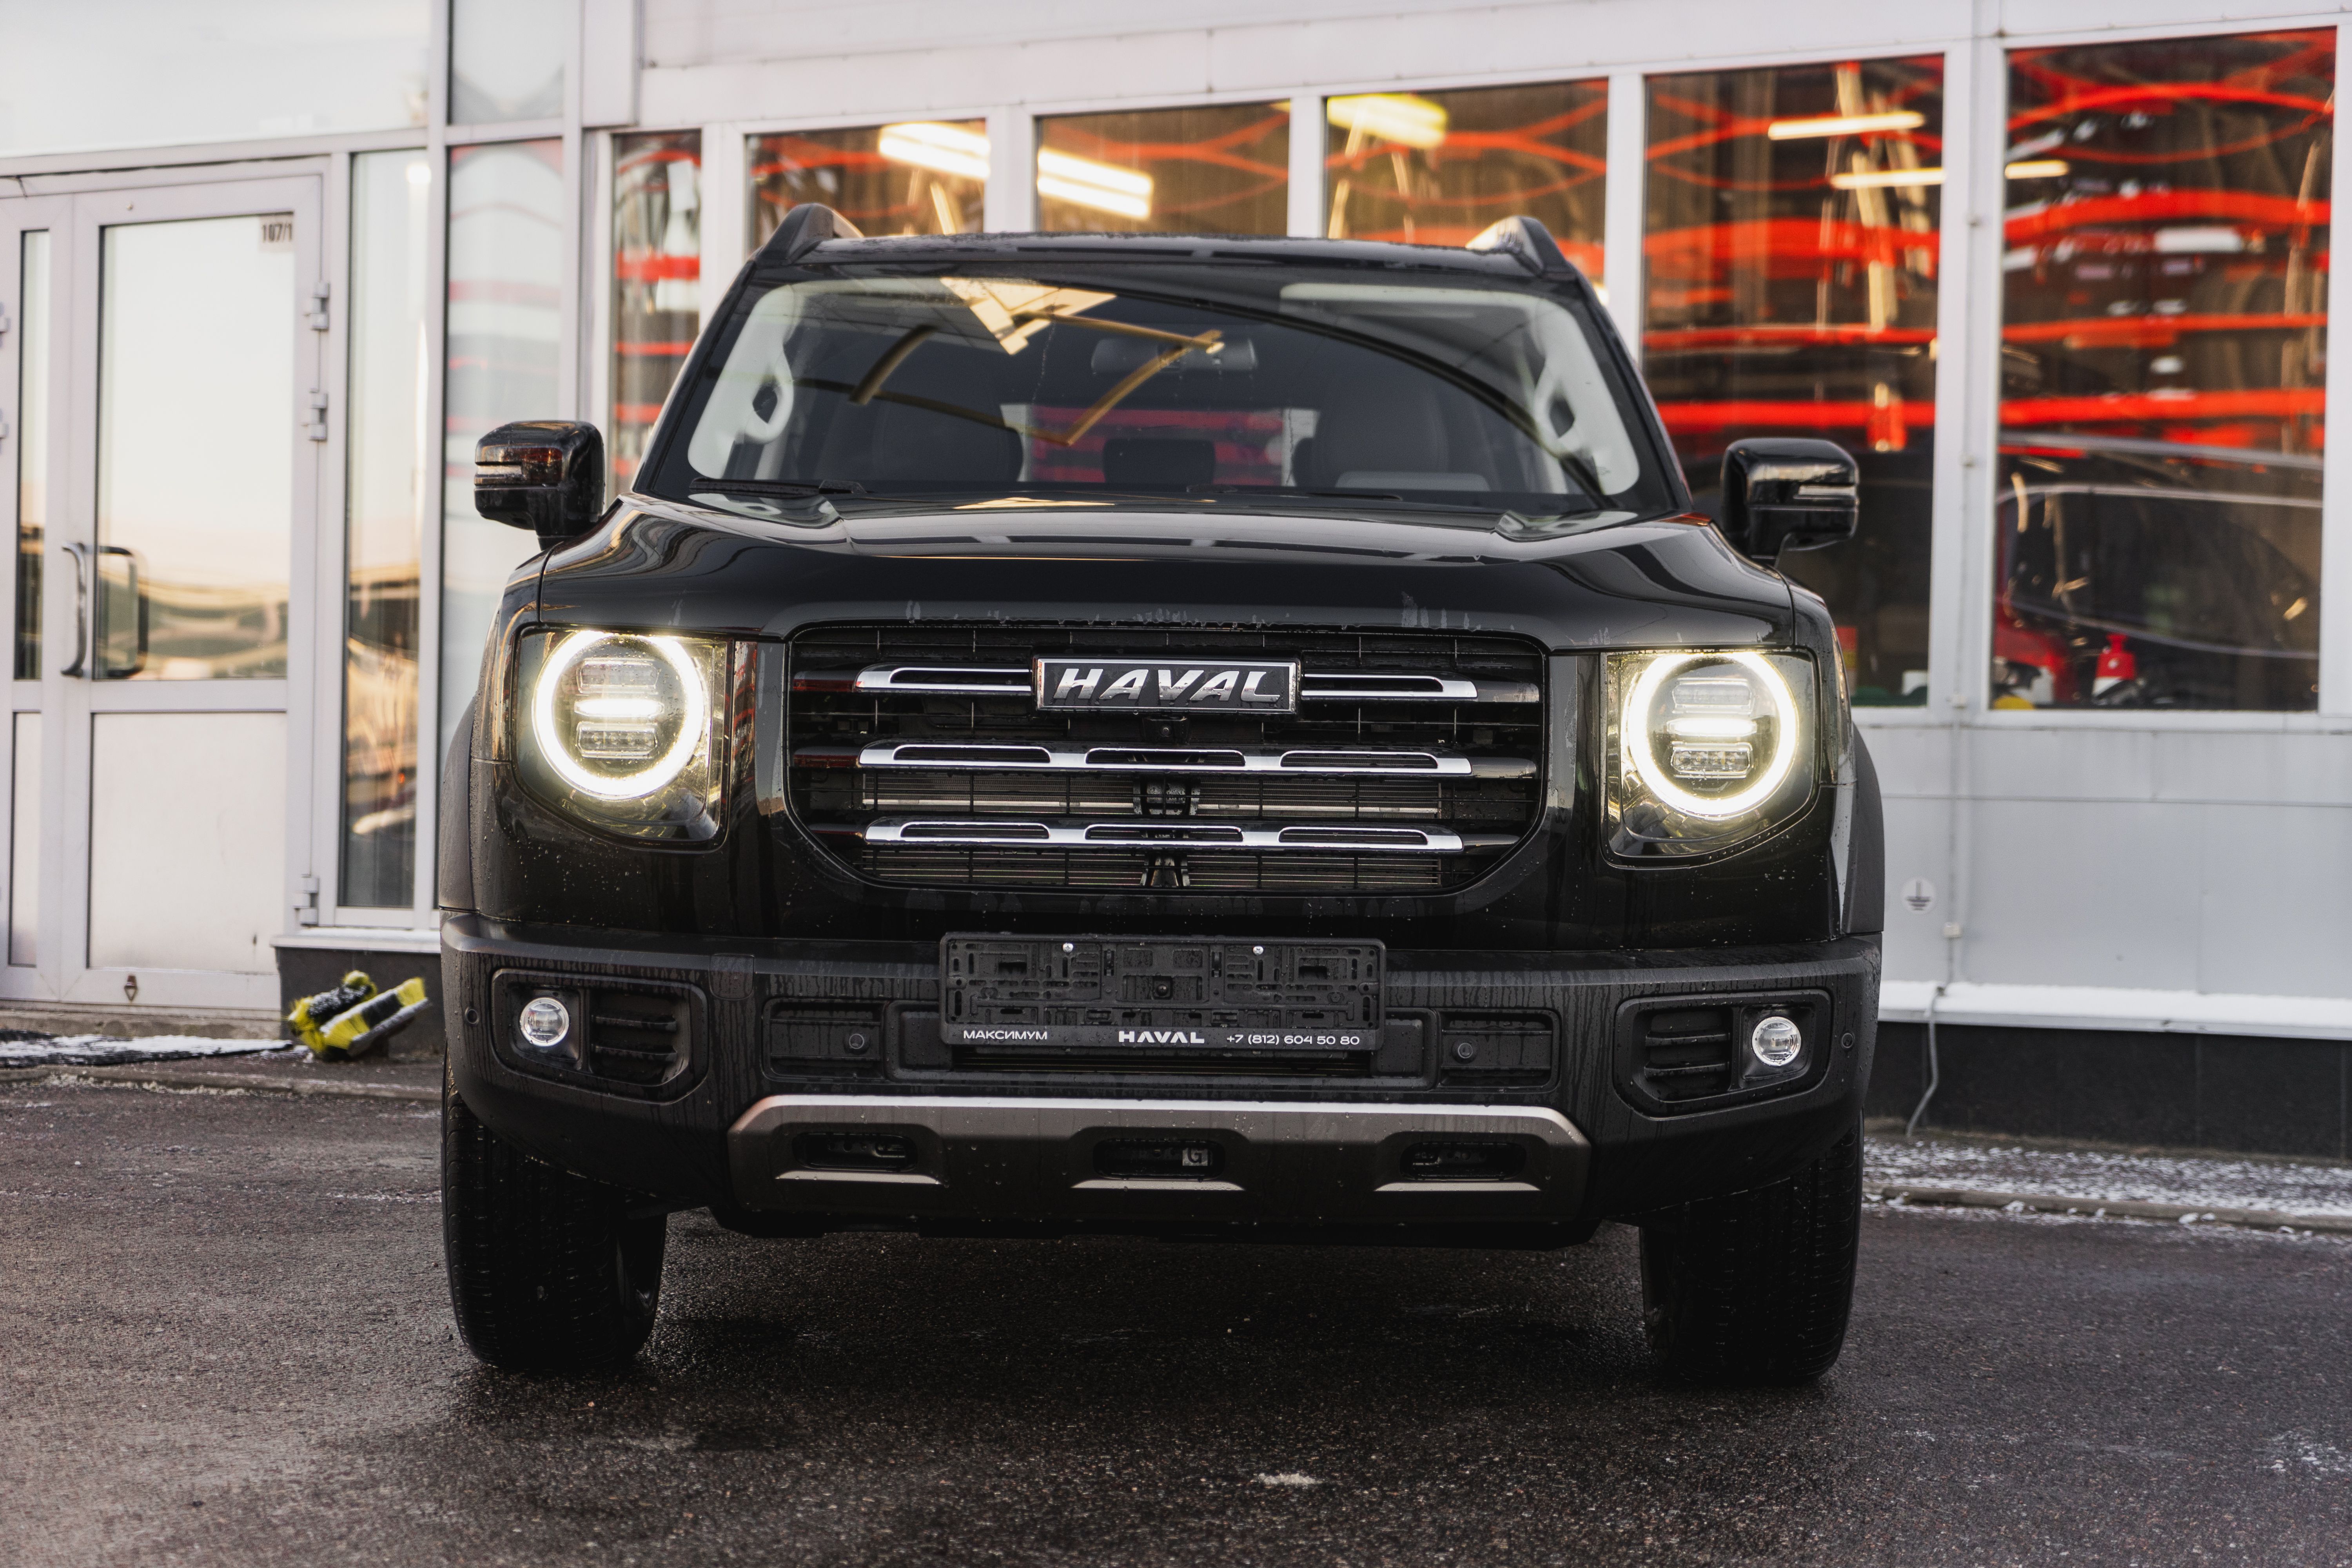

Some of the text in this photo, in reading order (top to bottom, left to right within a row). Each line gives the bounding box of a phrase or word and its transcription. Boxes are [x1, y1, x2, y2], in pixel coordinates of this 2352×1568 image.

[1053, 668, 1280, 702] HAVAL
[963, 1030, 1047, 1040] МАКСИМУМ
[1118, 1031, 1205, 1044] HAVAL
[1227, 1034, 1360, 1045] +7 (812) 604 50 80
